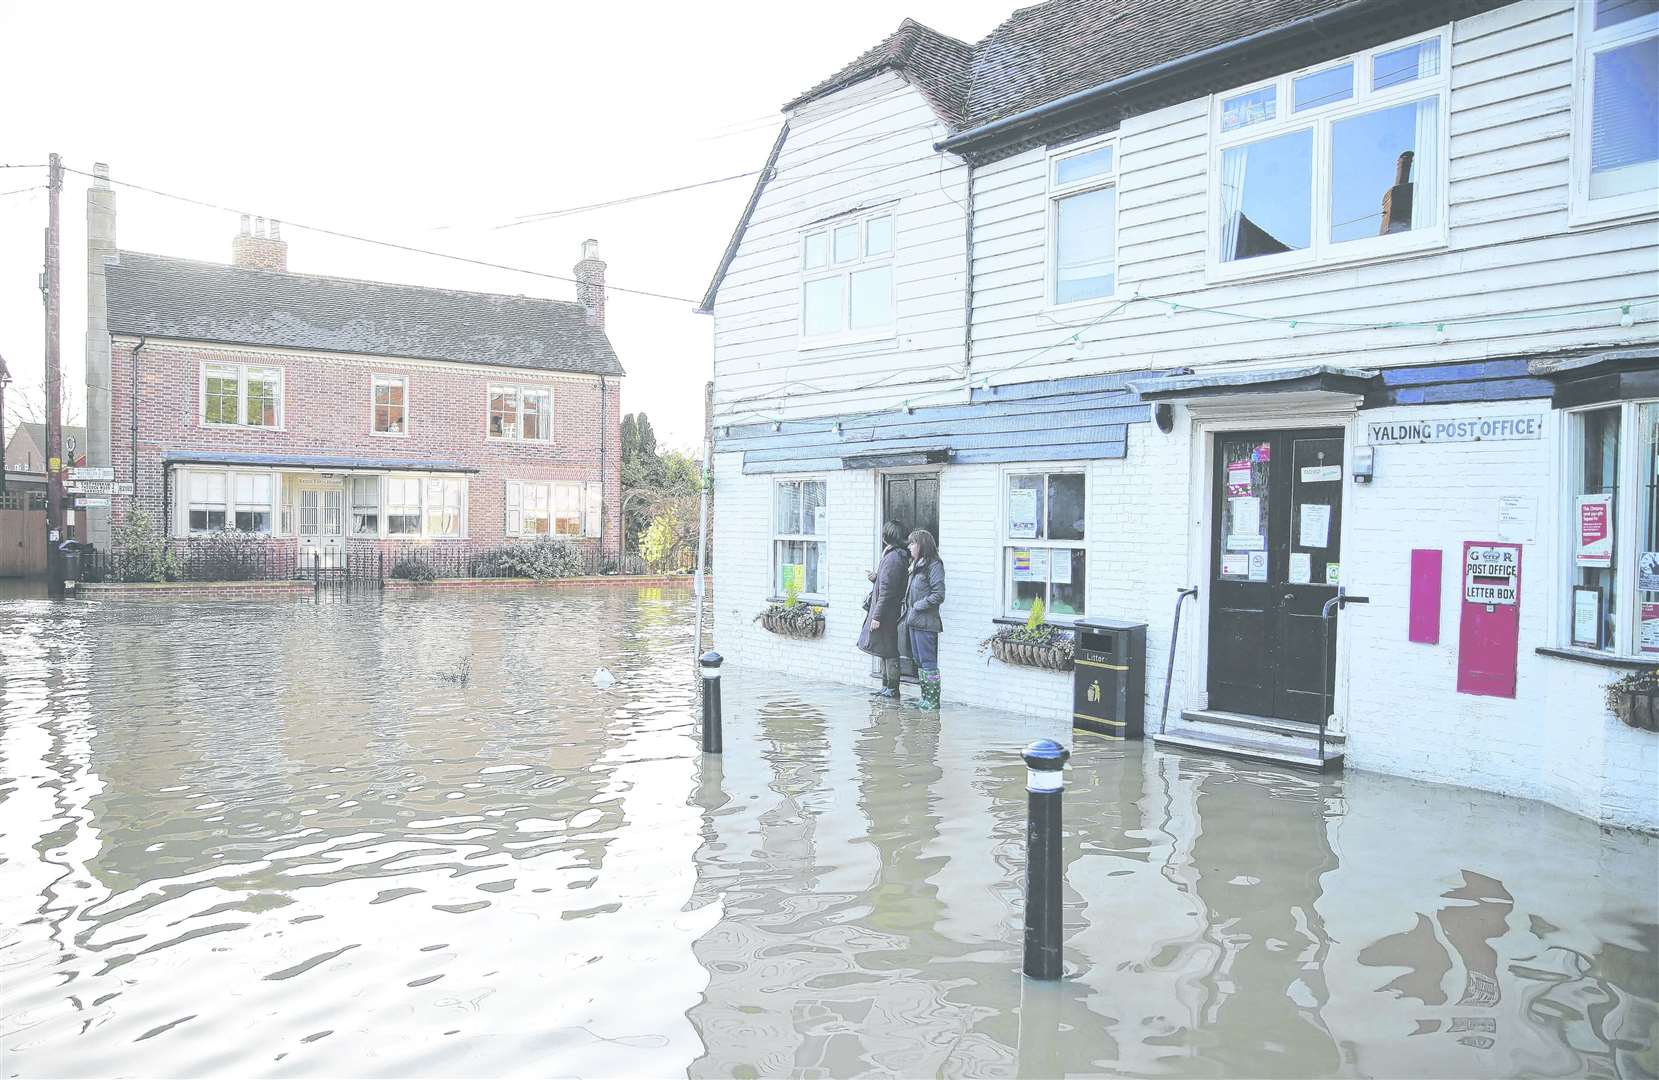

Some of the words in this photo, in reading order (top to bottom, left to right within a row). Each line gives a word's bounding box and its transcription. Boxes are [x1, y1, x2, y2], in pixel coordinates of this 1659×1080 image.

[1373, 424, 1431, 441] YALDING
[1436, 421, 1478, 438] POST
[1480, 418, 1535, 436] OFFICE
[1470, 551, 1479, 561] G
[1503, 552, 1513, 562] R
[1467, 563, 1487, 575] POST
[1488, 564, 1516, 576] OFFICE
[1467, 587, 1495, 598] LETTER
[1497, 588, 1514, 599] BOX
[1086, 652, 1105, 663] Litter
